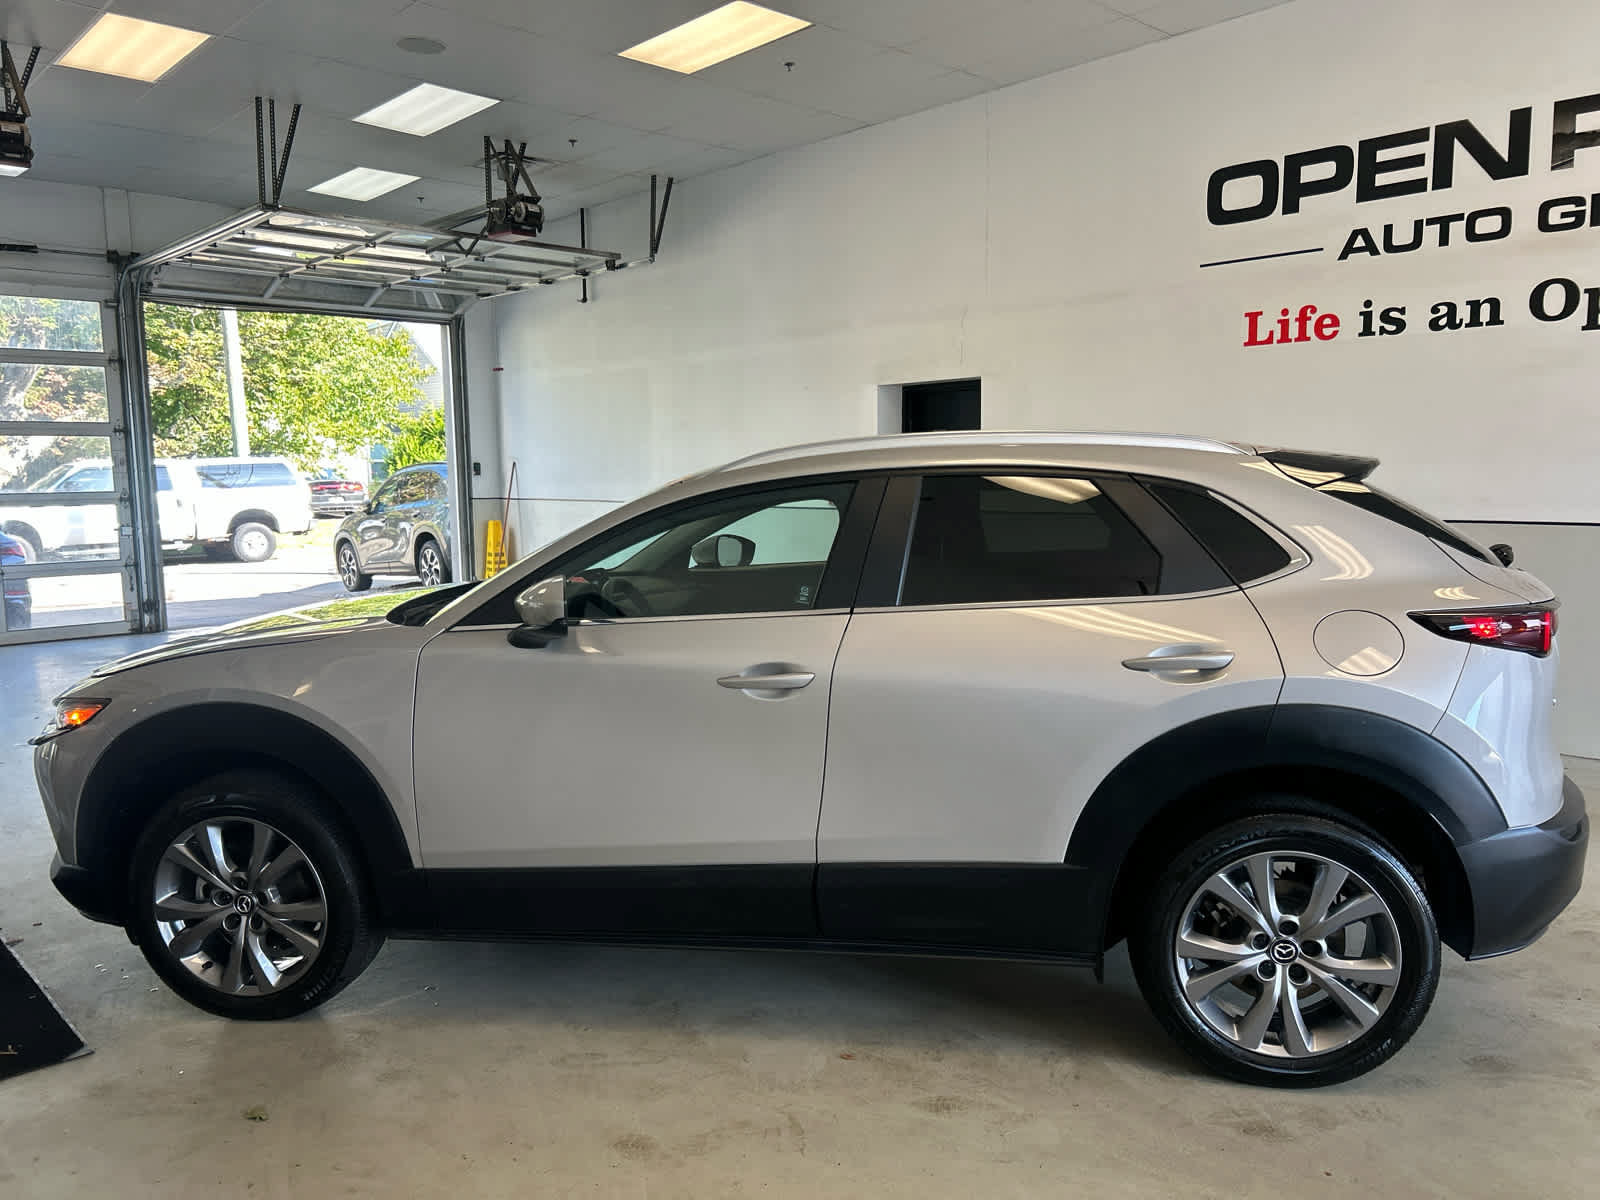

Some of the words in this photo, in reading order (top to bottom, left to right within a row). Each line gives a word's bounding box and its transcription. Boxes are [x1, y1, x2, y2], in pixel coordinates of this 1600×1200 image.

[1206, 106, 1533, 226] OPEN
[1337, 206, 1513, 261] AUTO
[1537, 192, 1600, 233] G
[1243, 304, 1341, 347] Life
[1357, 299, 1407, 338] is
[1428, 295, 1505, 332] an
